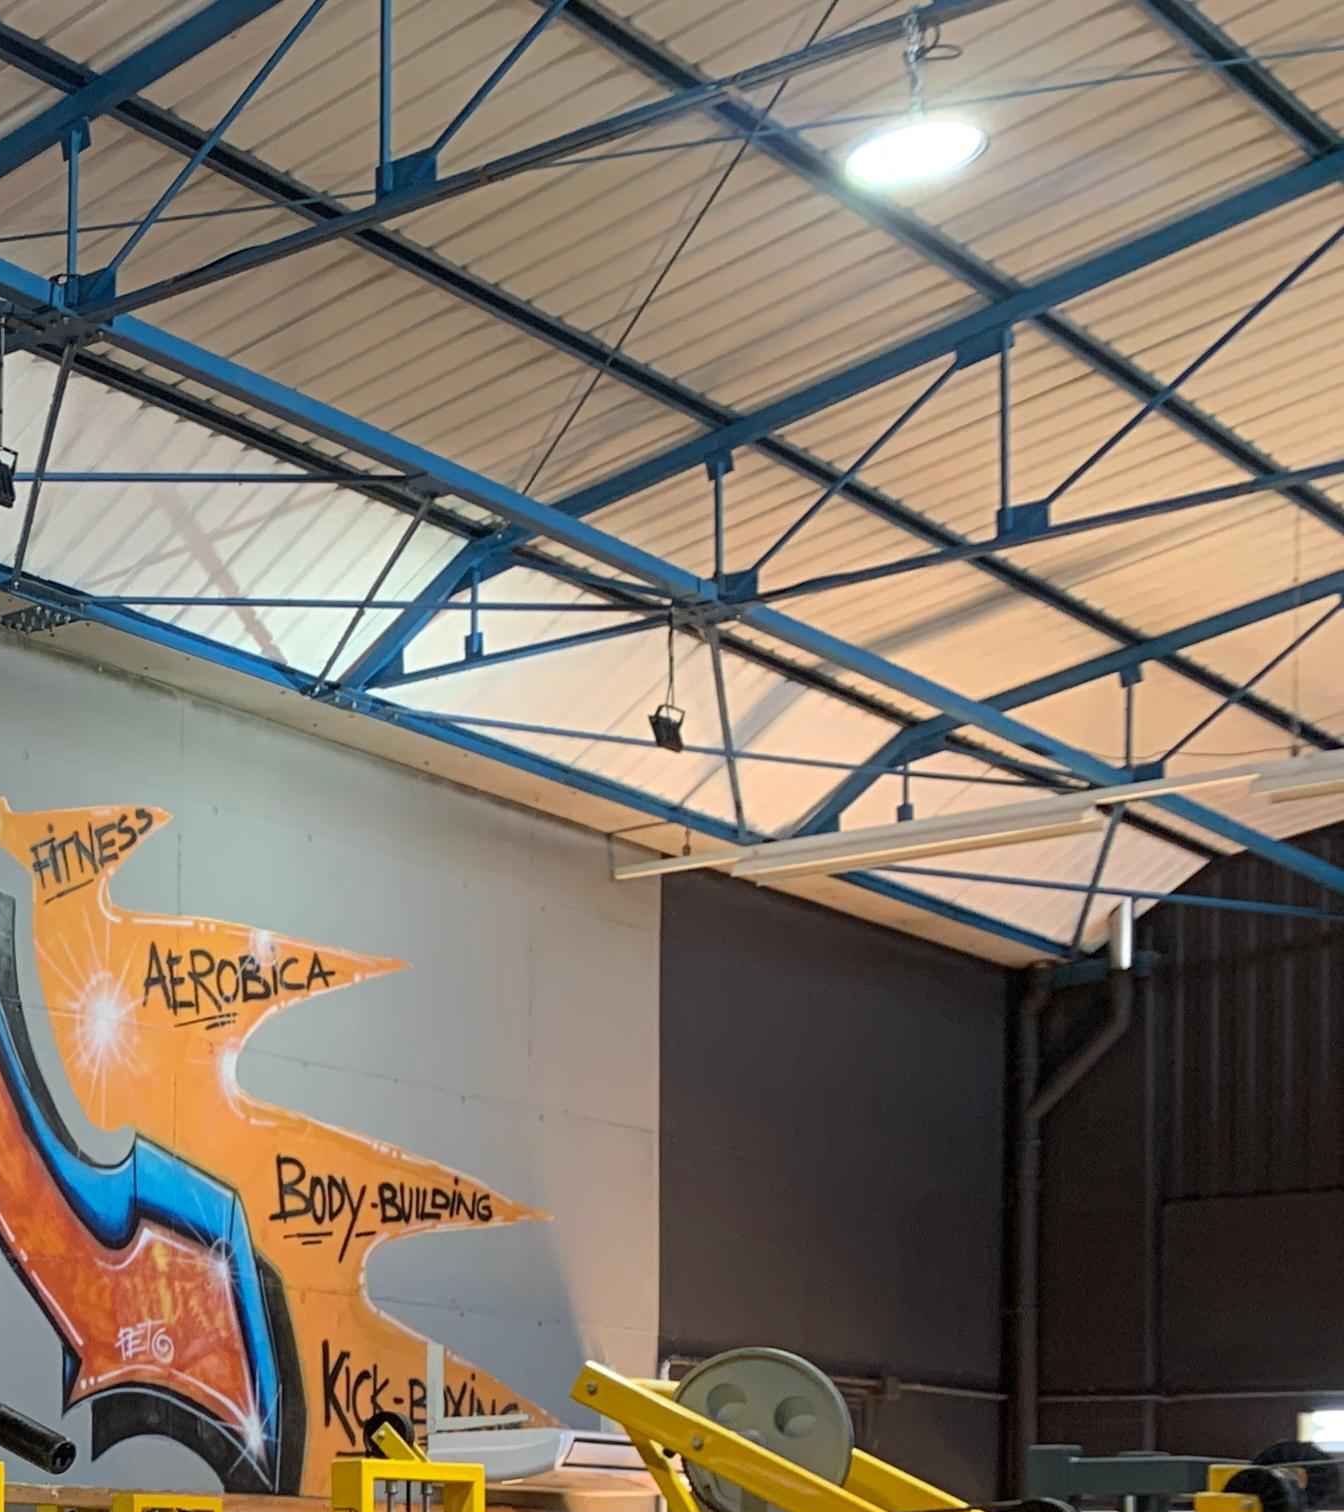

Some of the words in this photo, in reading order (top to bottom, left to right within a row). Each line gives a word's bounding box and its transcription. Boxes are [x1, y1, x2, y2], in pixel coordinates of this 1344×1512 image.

[30, 807, 154, 889] FITNESS
[142, 940, 337, 1014] AEROBICA
[269, 1154, 494, 1263] BODY-BUILDING
